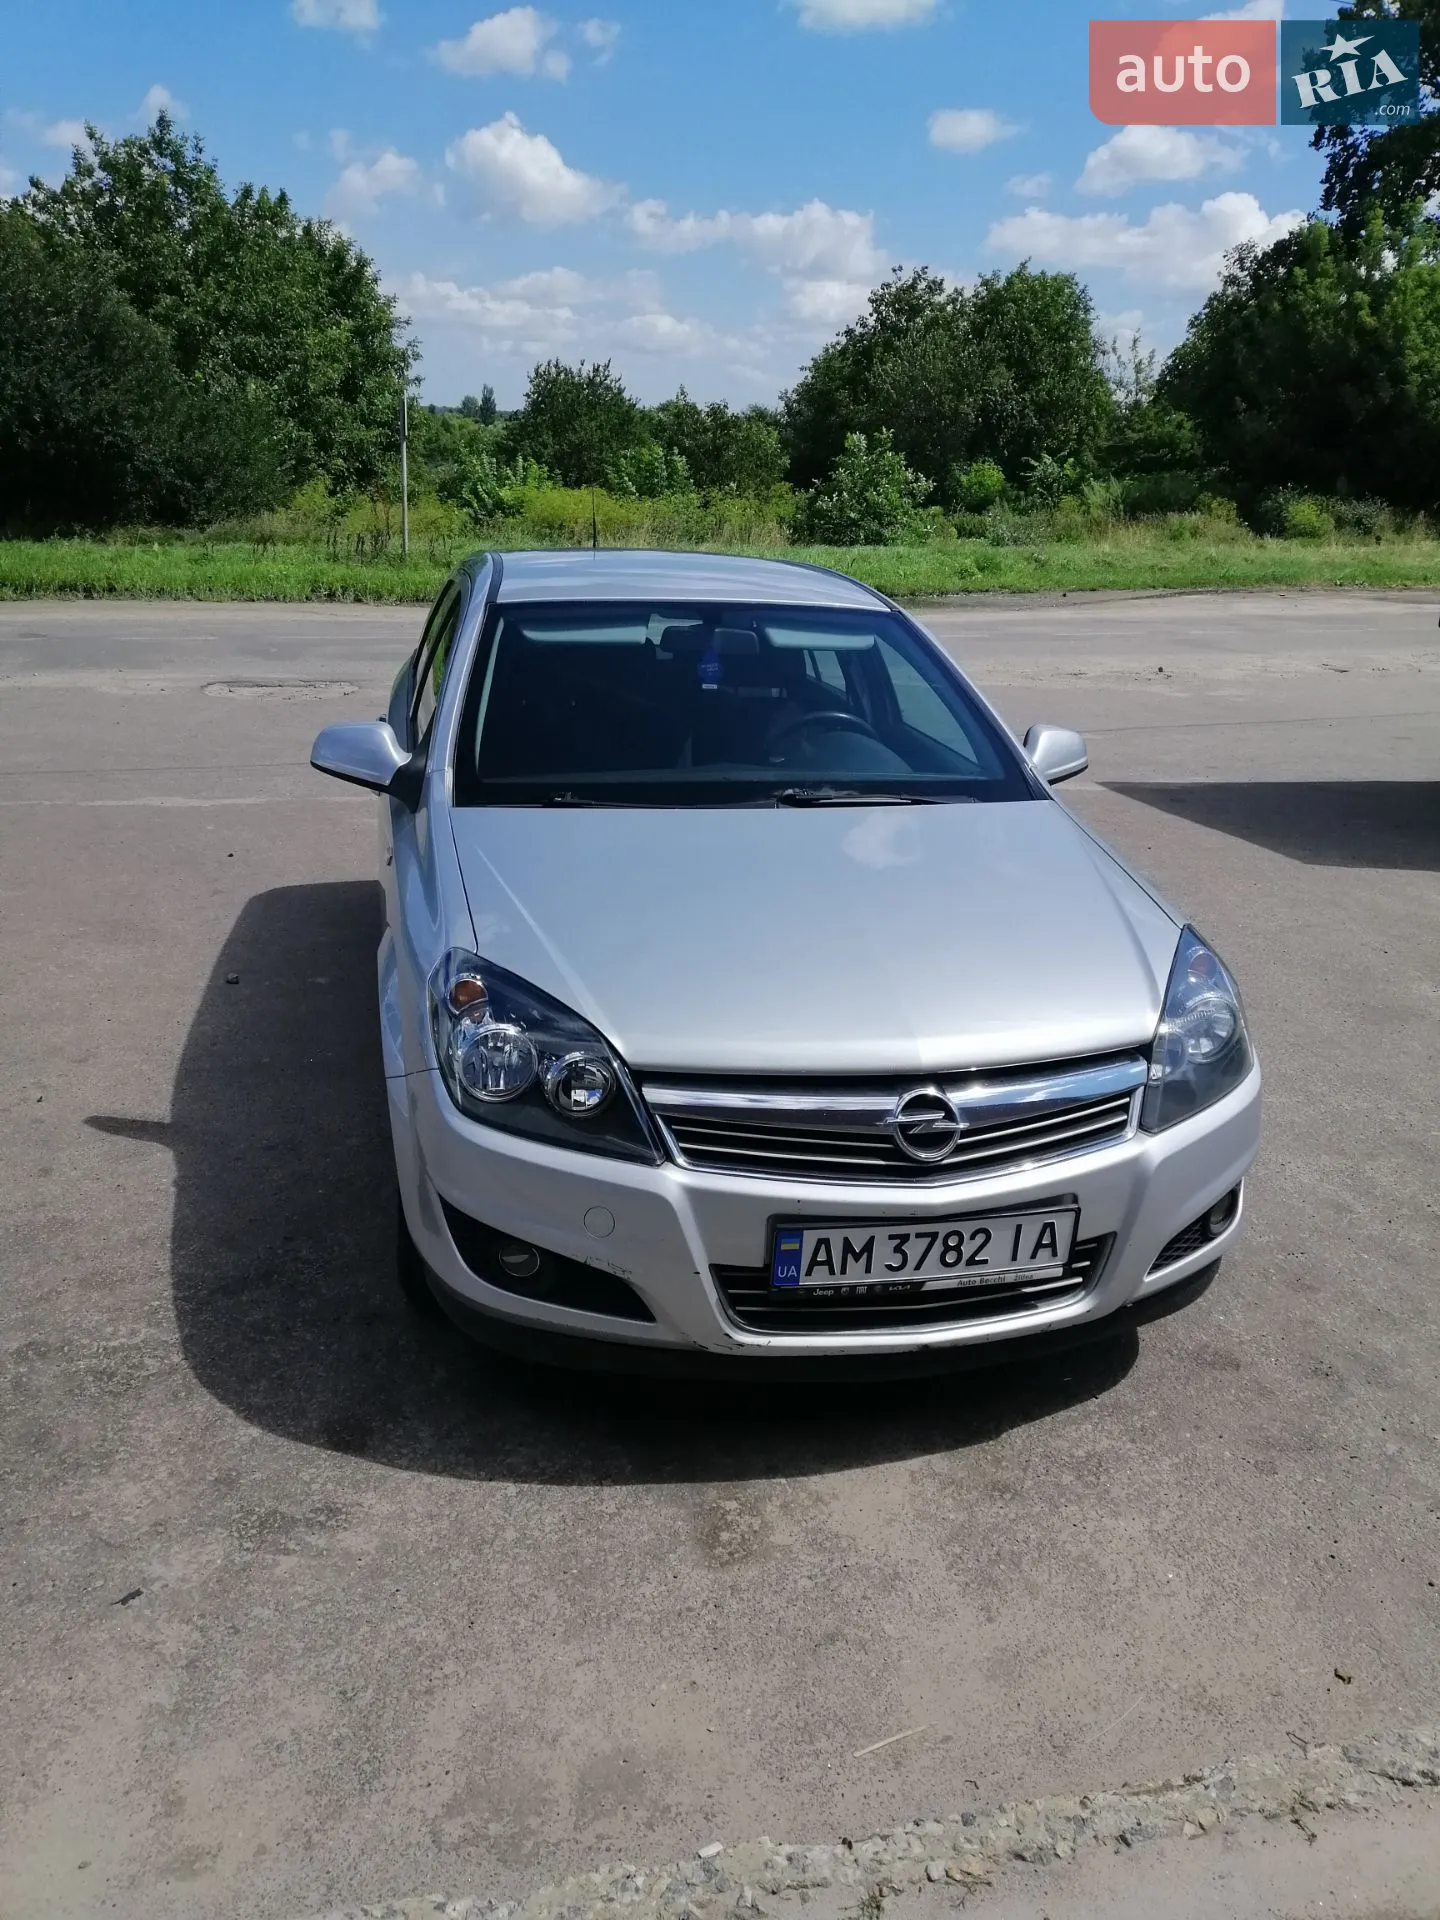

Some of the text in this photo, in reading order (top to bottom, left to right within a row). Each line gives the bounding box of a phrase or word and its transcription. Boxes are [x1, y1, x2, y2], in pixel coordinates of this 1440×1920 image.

[805, 1221, 1059, 1277] AM 3782 IA
[778, 1265, 798, 1279] UA
[957, 1279, 976, 1287] Auto
[813, 1288, 834, 1296] Jeep
